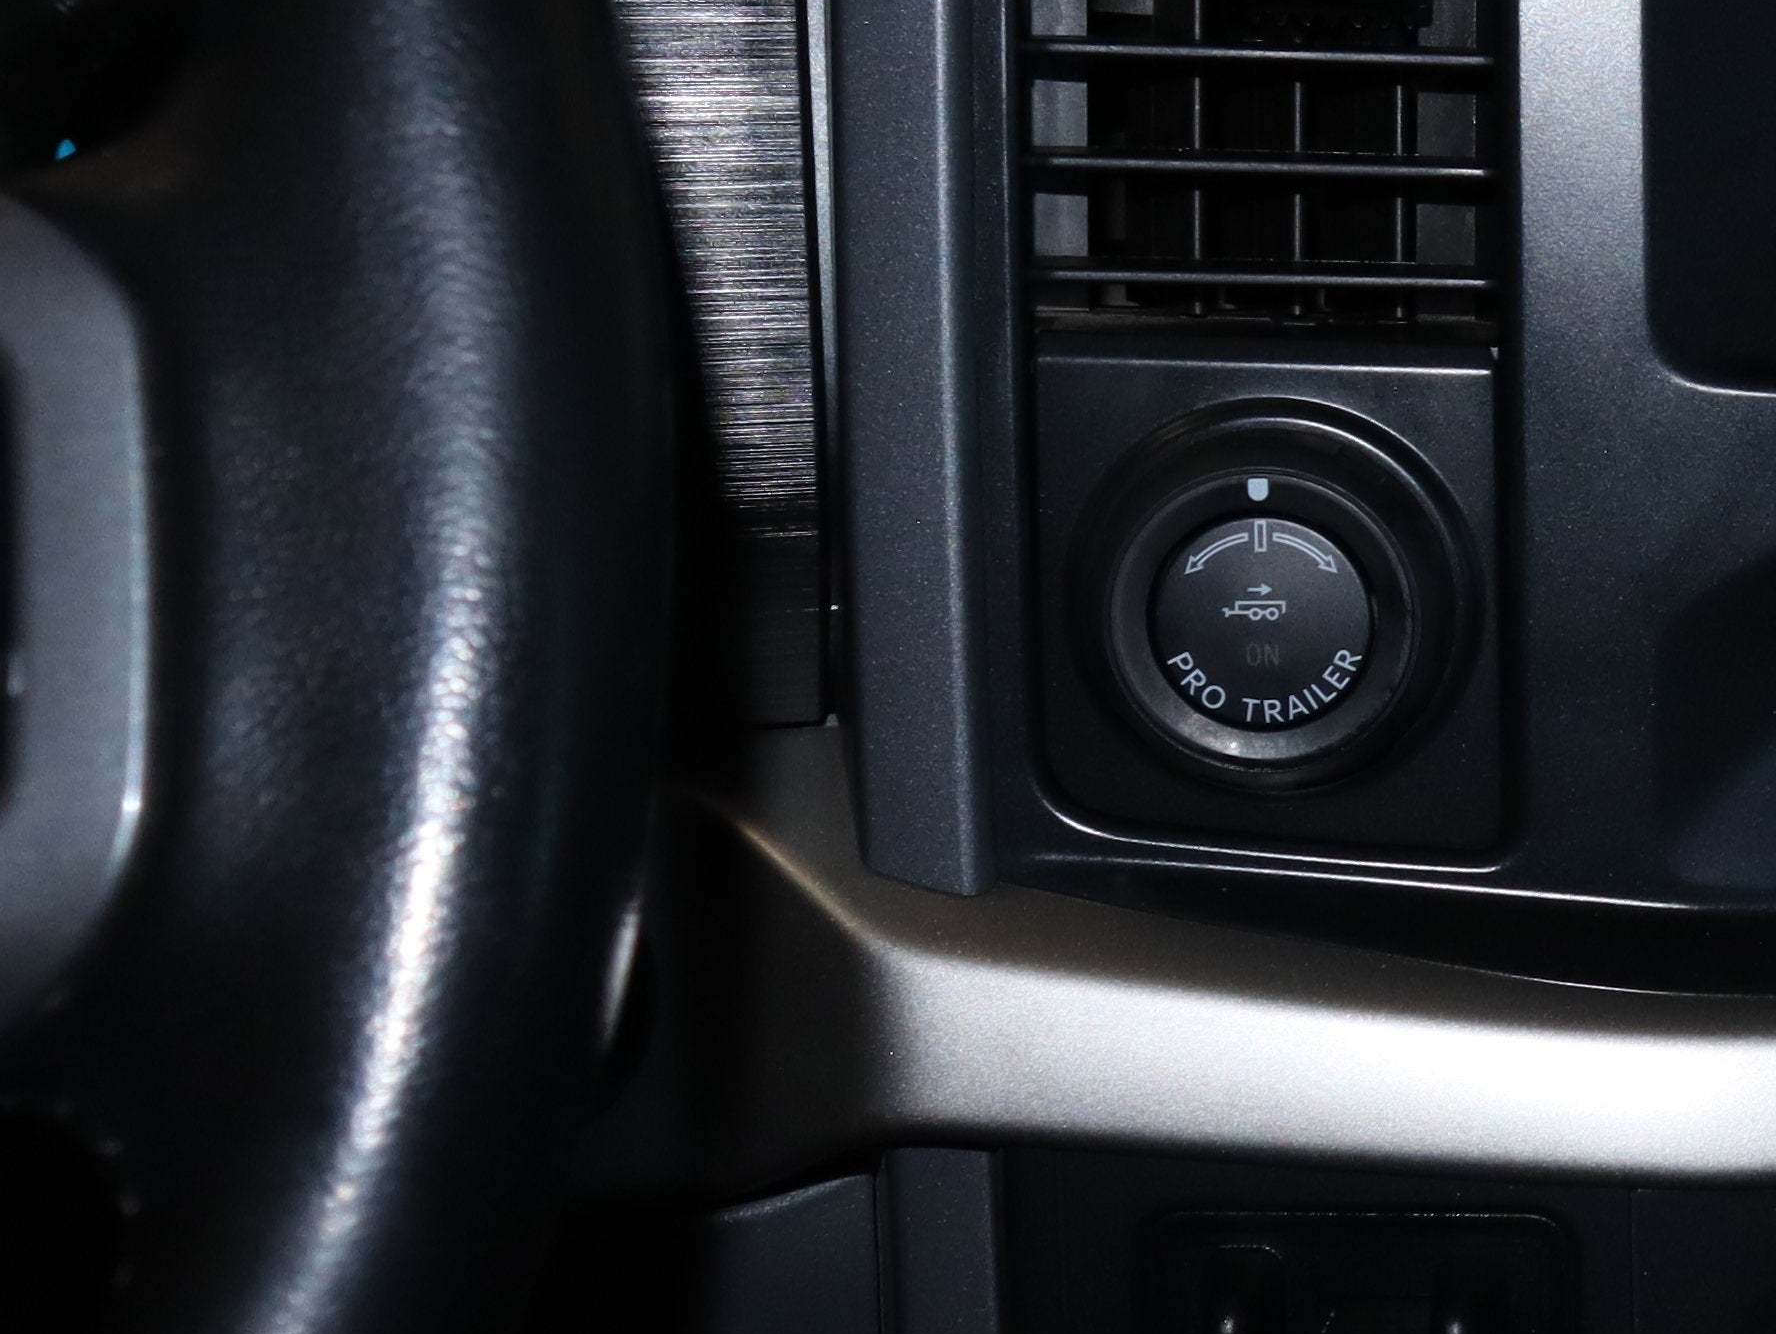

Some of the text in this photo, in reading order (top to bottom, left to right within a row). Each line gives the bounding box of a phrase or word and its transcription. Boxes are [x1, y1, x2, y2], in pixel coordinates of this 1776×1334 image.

[1245, 643, 1280, 668] ON
[1166, 647, 1363, 724] PRO TRAILER
